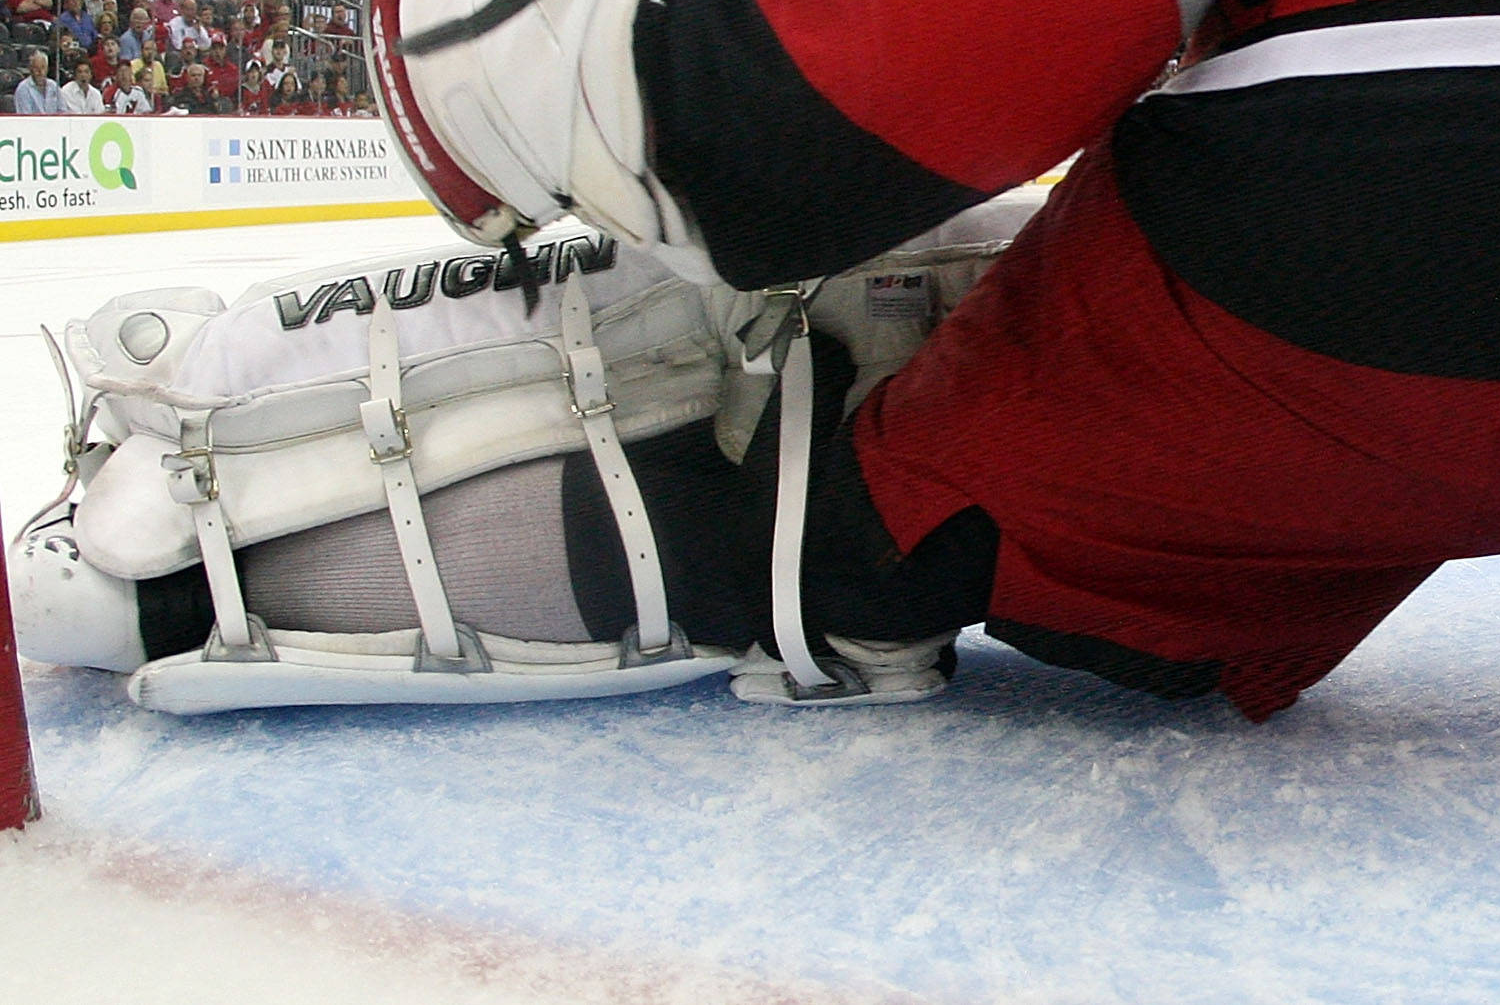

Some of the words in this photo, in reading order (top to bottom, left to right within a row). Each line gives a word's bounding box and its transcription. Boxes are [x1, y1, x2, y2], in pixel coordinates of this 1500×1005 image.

[247, 140, 298, 160] SAINT
[301, 139, 387, 159] BARNABAS
[247, 168, 300, 183] HEALTH
[304, 167, 336, 182] CARE
[338, 166, 388, 181] SYSTEM
[36, 190, 58, 208] Go
[63, 188, 96, 207] fast.
[273, 232, 619, 332] VAUGHN
